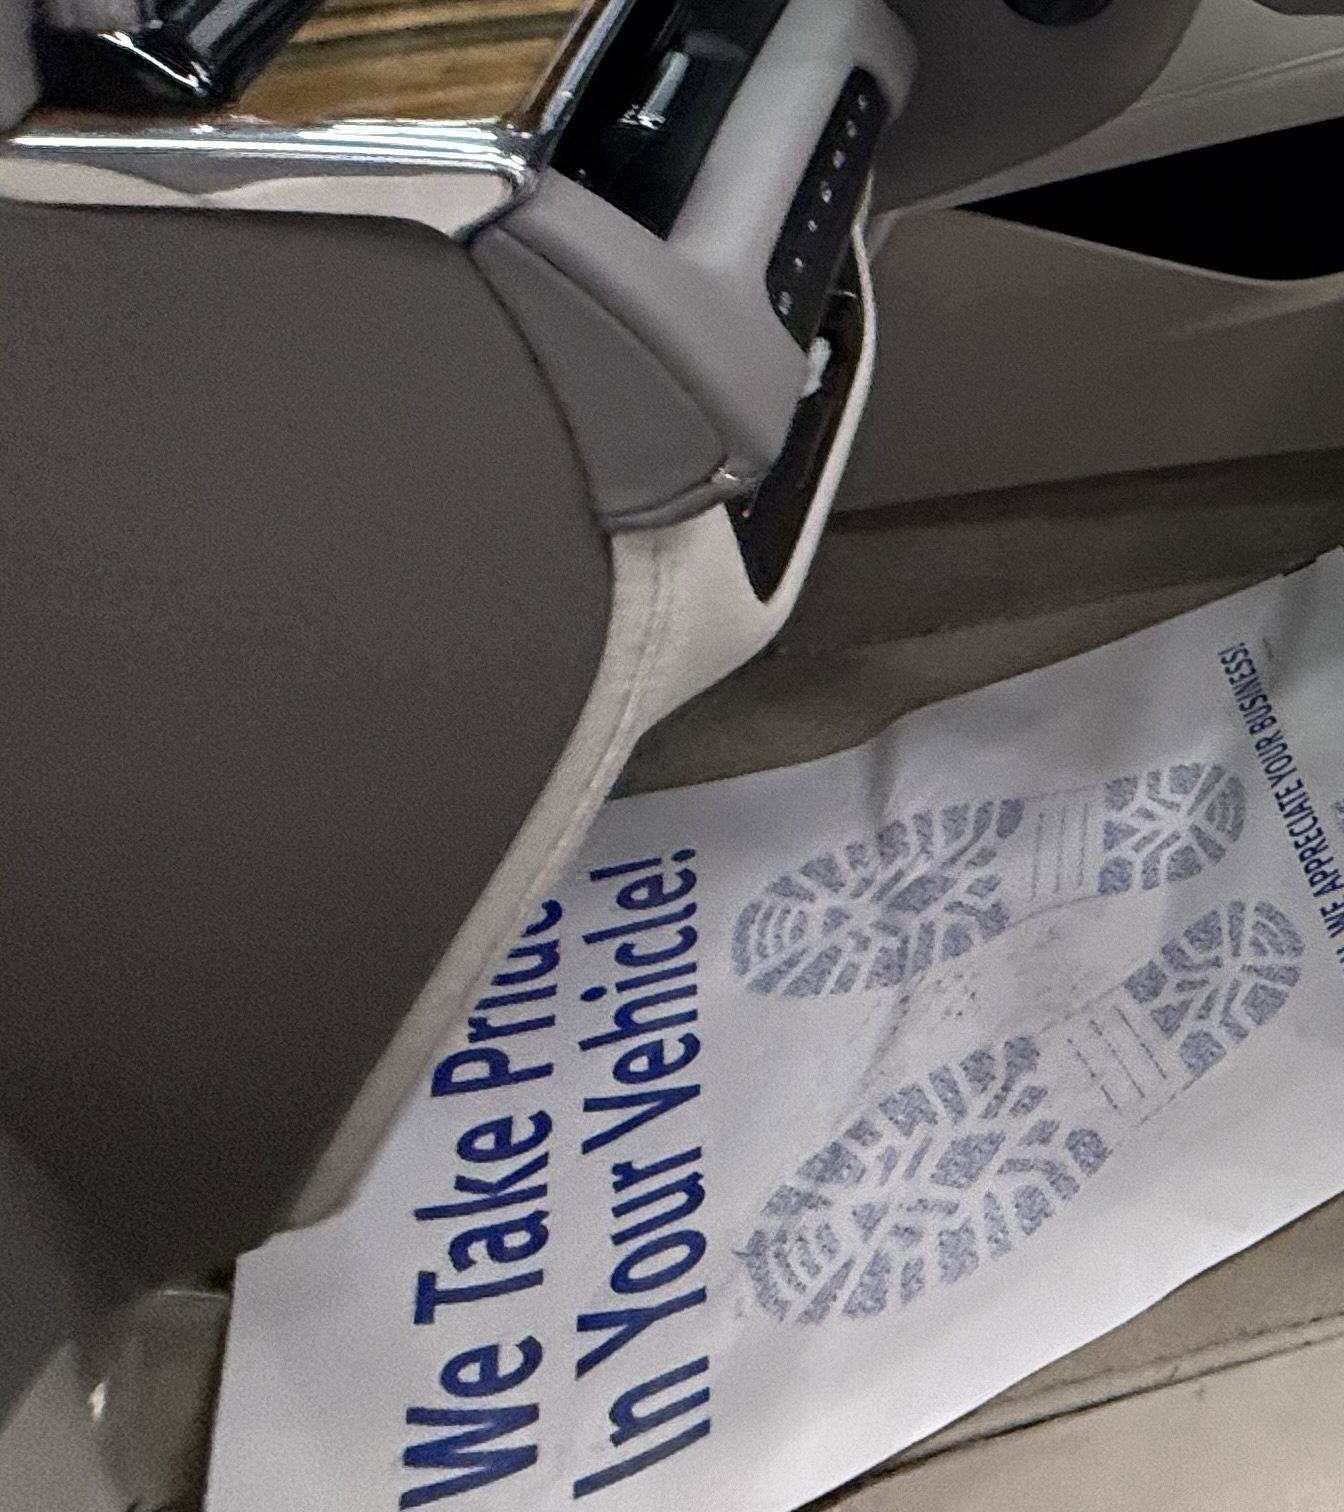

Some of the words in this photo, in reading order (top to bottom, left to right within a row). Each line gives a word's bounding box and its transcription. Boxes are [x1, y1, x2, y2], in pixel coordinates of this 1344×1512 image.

[1217, 641, 1278, 736] BUSINESS!
[1254, 728, 1298, 790] YOUR
[580, 848, 701, 1155] Vehicle!
[414, 1110, 553, 1325] Take
[576, 1146, 708, 1379] Your
[400, 1336, 543, 1509] We
[573, 1356, 711, 1500] In
